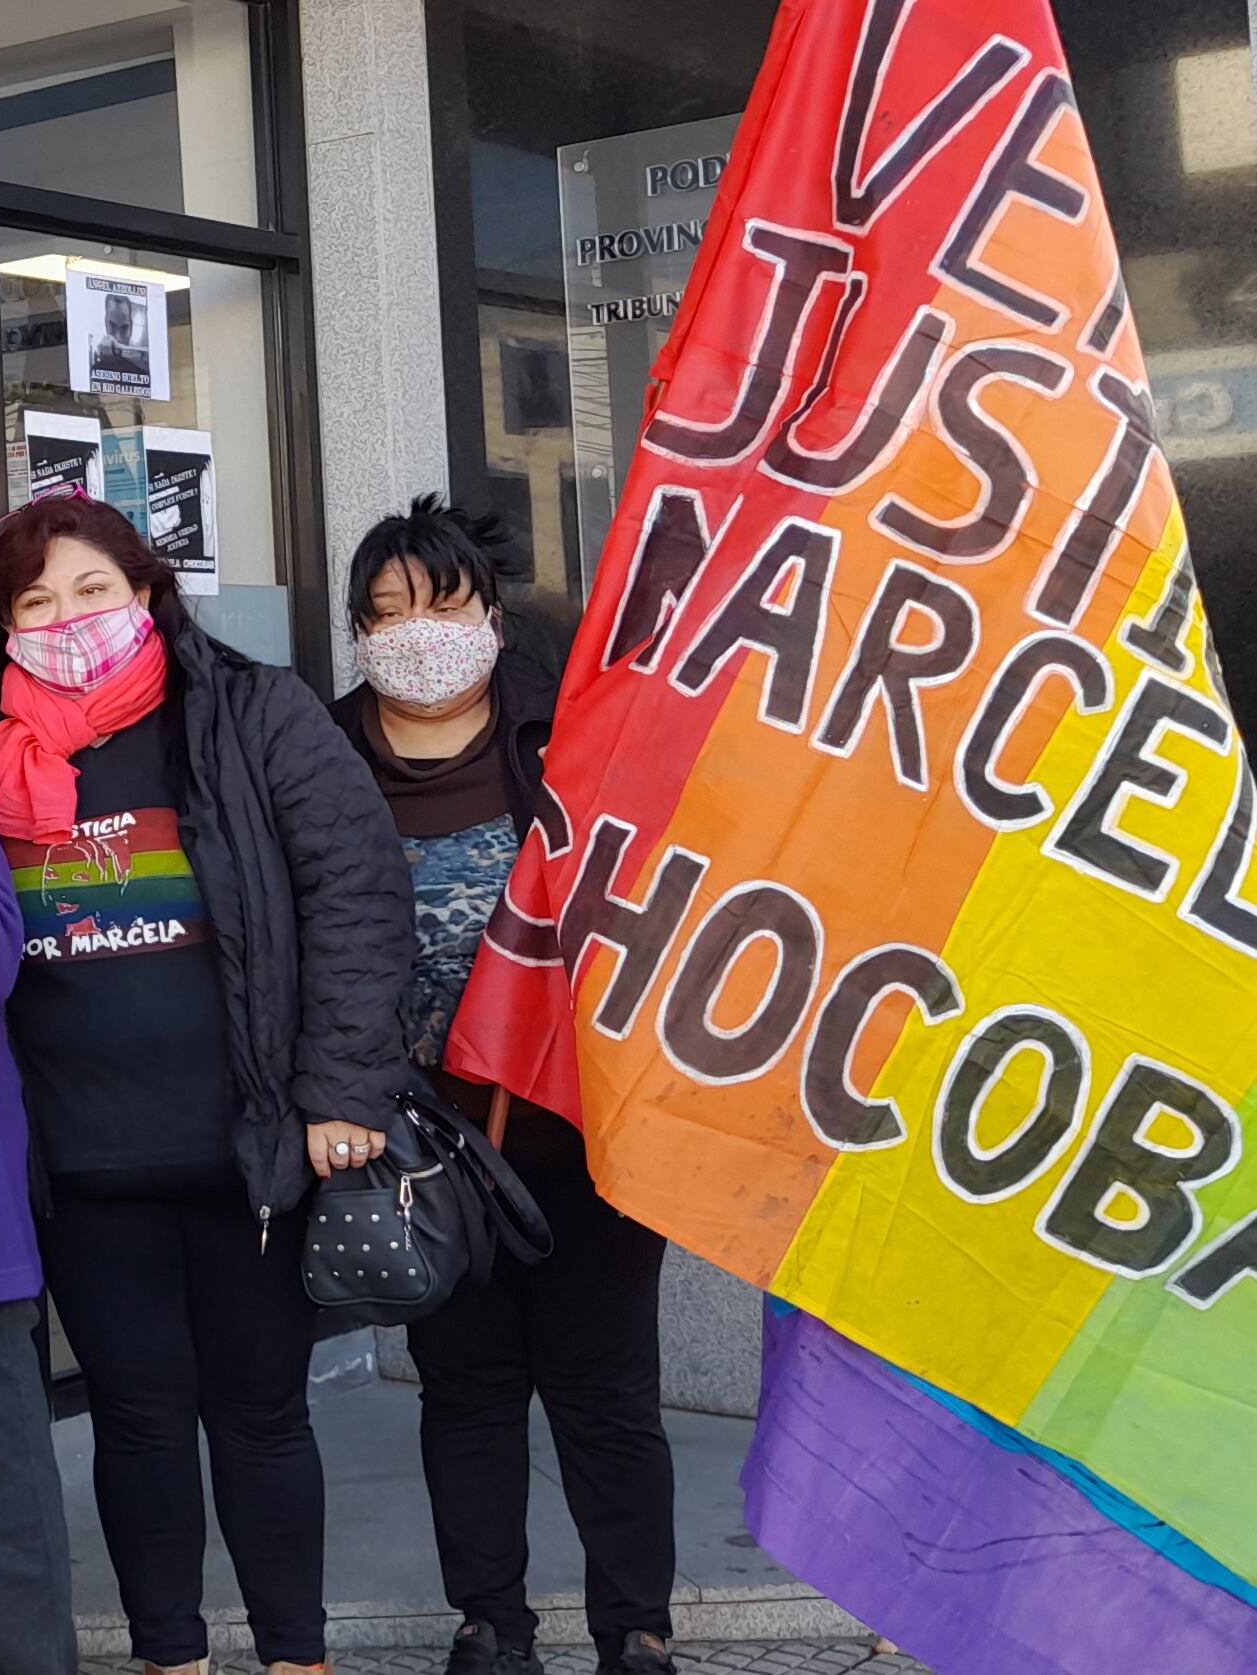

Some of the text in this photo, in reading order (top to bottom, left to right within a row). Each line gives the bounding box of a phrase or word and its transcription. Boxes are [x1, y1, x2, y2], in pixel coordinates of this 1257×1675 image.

[646, 152, 730, 196] POD
[587, 289, 685, 325] TRIBUN
[103, 449, 141, 465] virus
[599, 482, 1257, 962] MARCEL
[71, 812, 137, 839] STICIA
[21, 919, 187, 961] OR MARCELA
